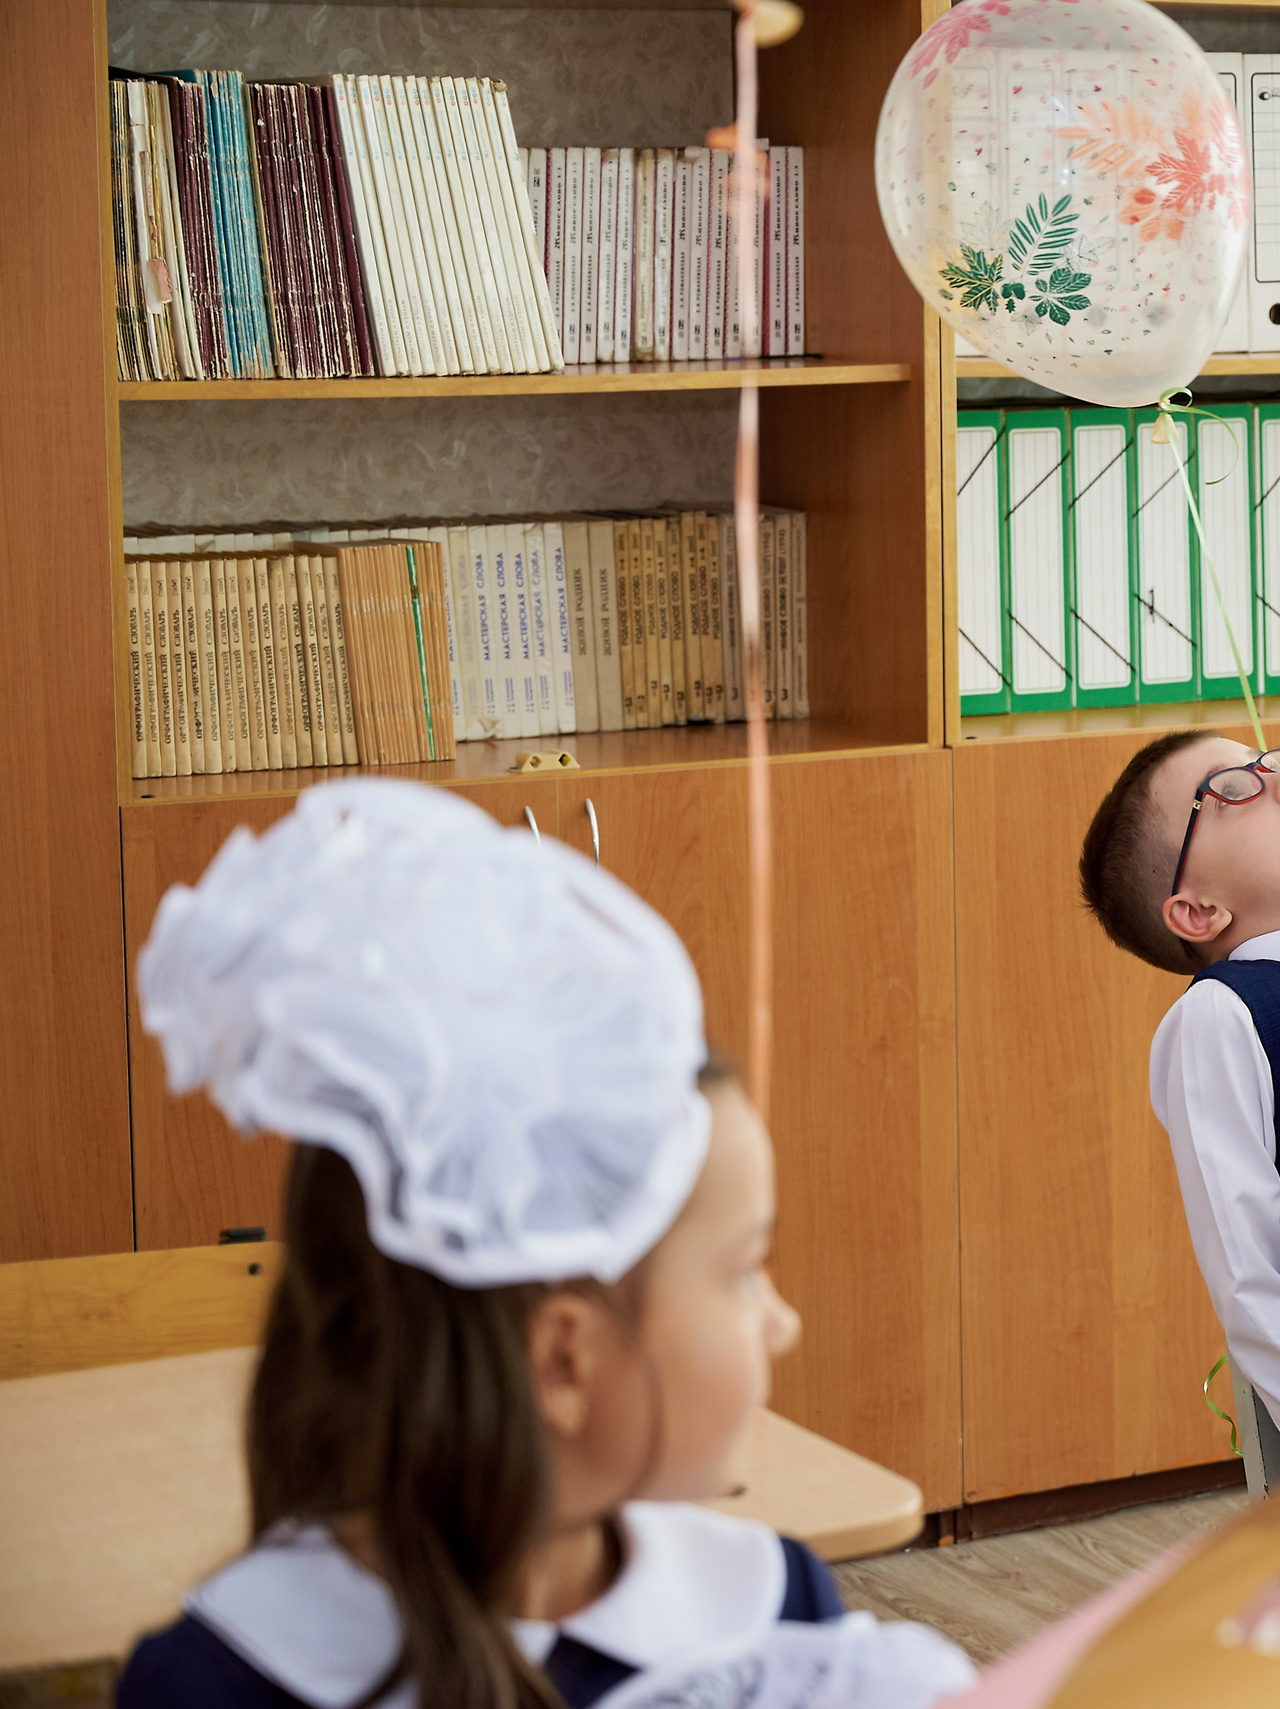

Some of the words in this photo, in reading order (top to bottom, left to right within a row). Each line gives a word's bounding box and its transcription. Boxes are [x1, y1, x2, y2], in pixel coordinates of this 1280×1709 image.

[497, 553, 505, 587] СЛОВА
[515, 553, 524, 587] СЛОВА
[555, 546, 563, 582] СЛОВА
[262, 603, 270, 639] СЛОВАРЬ
[479, 595, 490, 661] МАСТЕРСКАЯ
[499, 594, 511, 659] МАСТЕРСКАЯ
[518, 594, 529, 659] МАСТЕРСКАЯ
[558, 588, 569, 653] МАСТЕРСКАЯ
[160, 654, 171, 744] ОРФОГРАФИЧЕСКИЙ
[264, 646, 278, 734] ОРФОГРАФИЧЕСКИЙ
